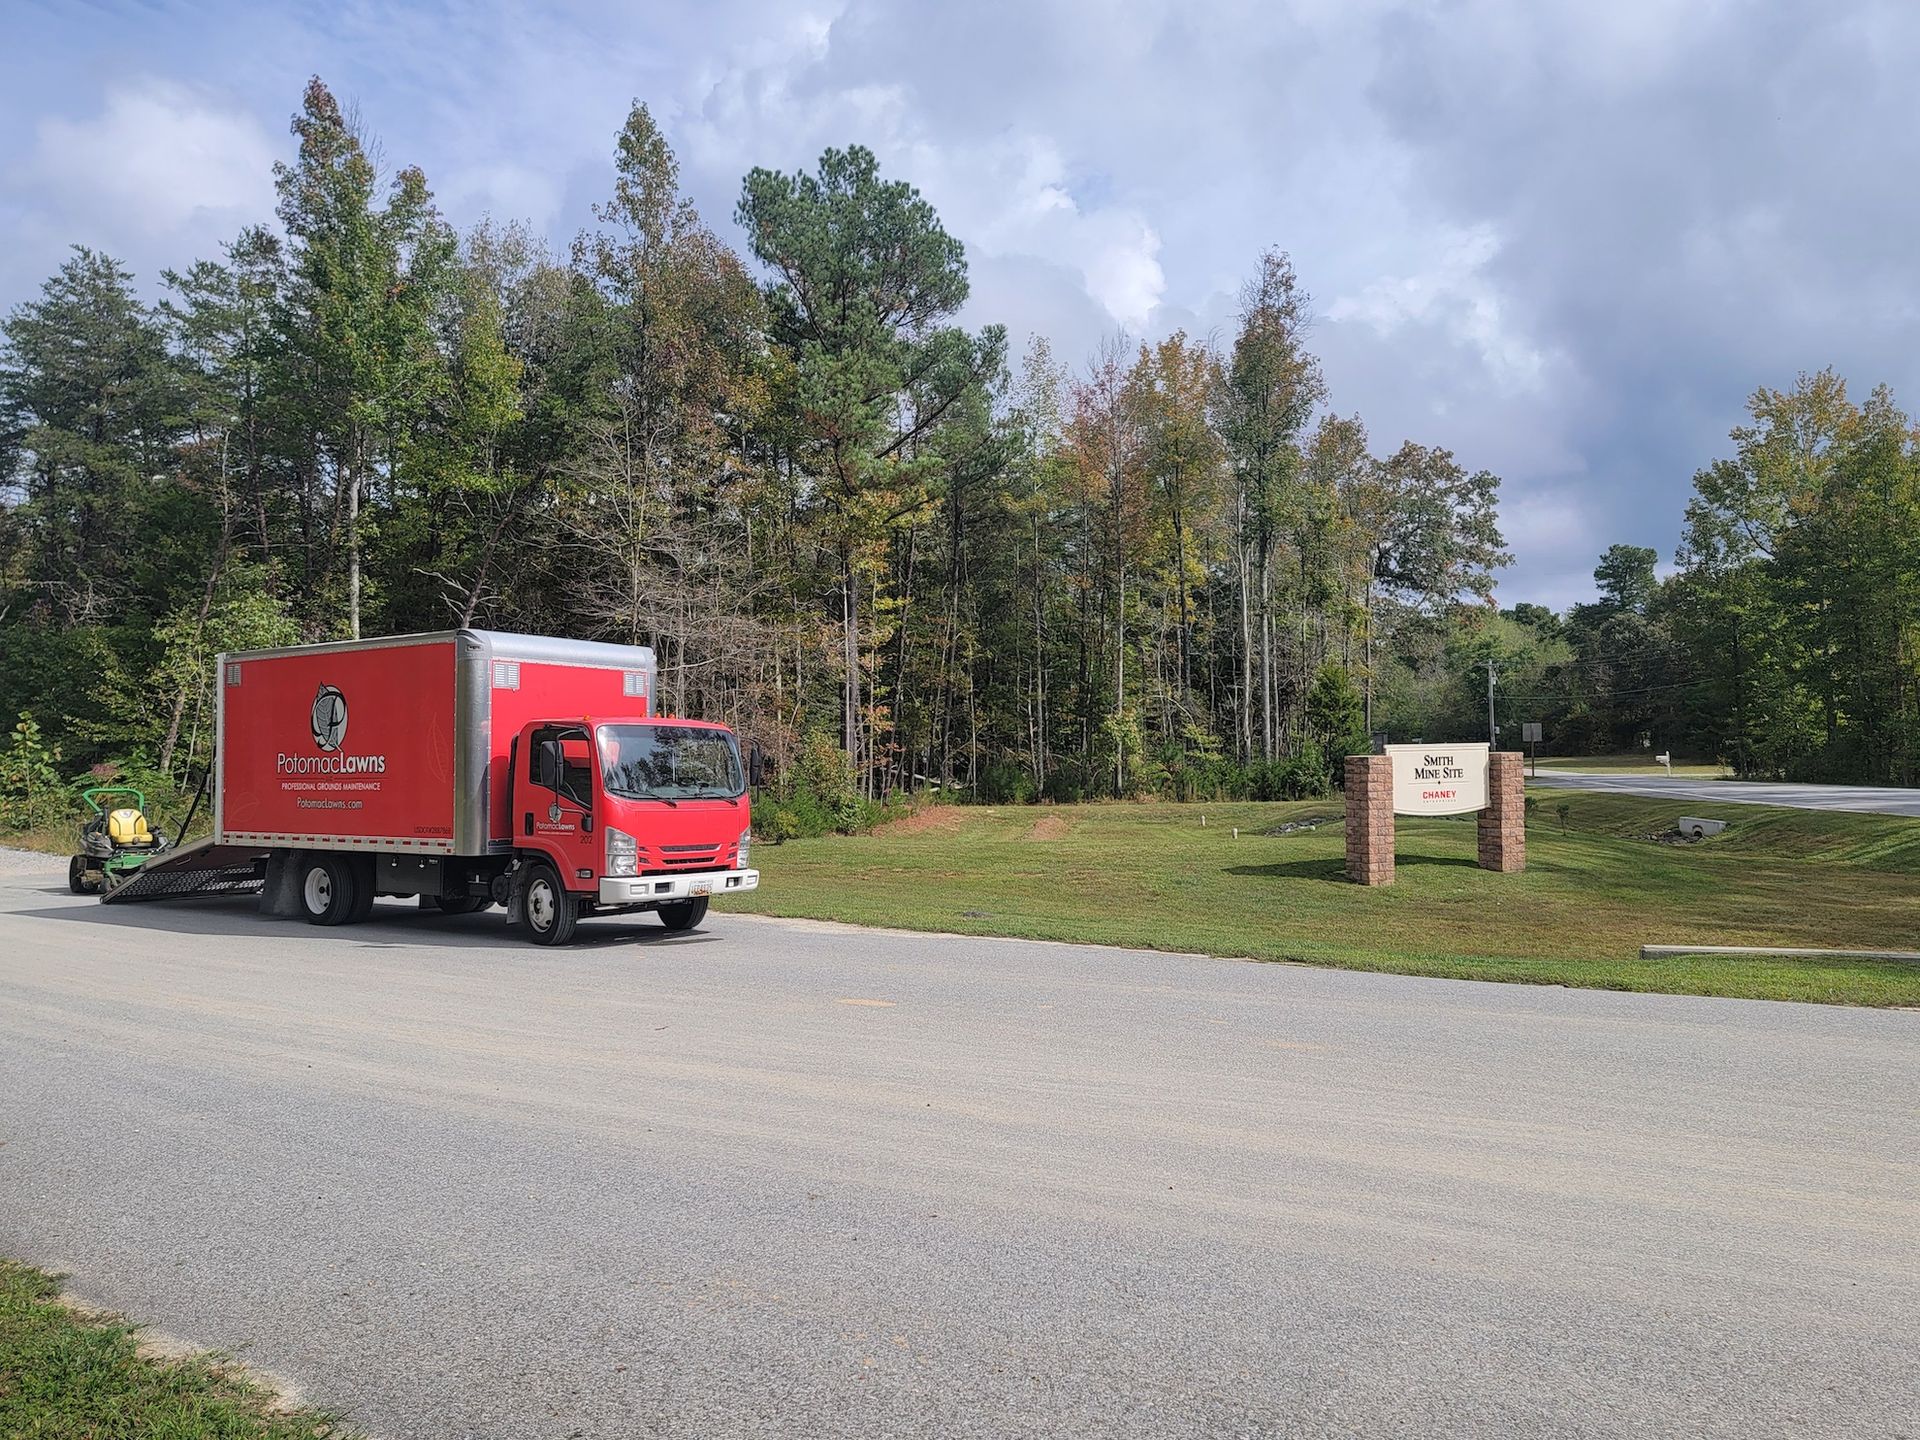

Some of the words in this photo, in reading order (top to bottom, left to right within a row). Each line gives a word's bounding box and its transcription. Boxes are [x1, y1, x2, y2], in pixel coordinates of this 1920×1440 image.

[277, 752, 386, 774] PotomacLawns
[1424, 754, 1454, 766] SMITH
[1414, 768, 1440, 779] MINE
[1443, 767, 1464, 779] SITE
[282, 783, 316, 791] PROFESSIONAL
[317, 783, 342, 791] GROUNDS
[343, 782, 381, 791] MAINTENANCE
[1422, 790, 1457, 799] CHANEY
[297, 797, 363, 810] PotomacLawns.com
